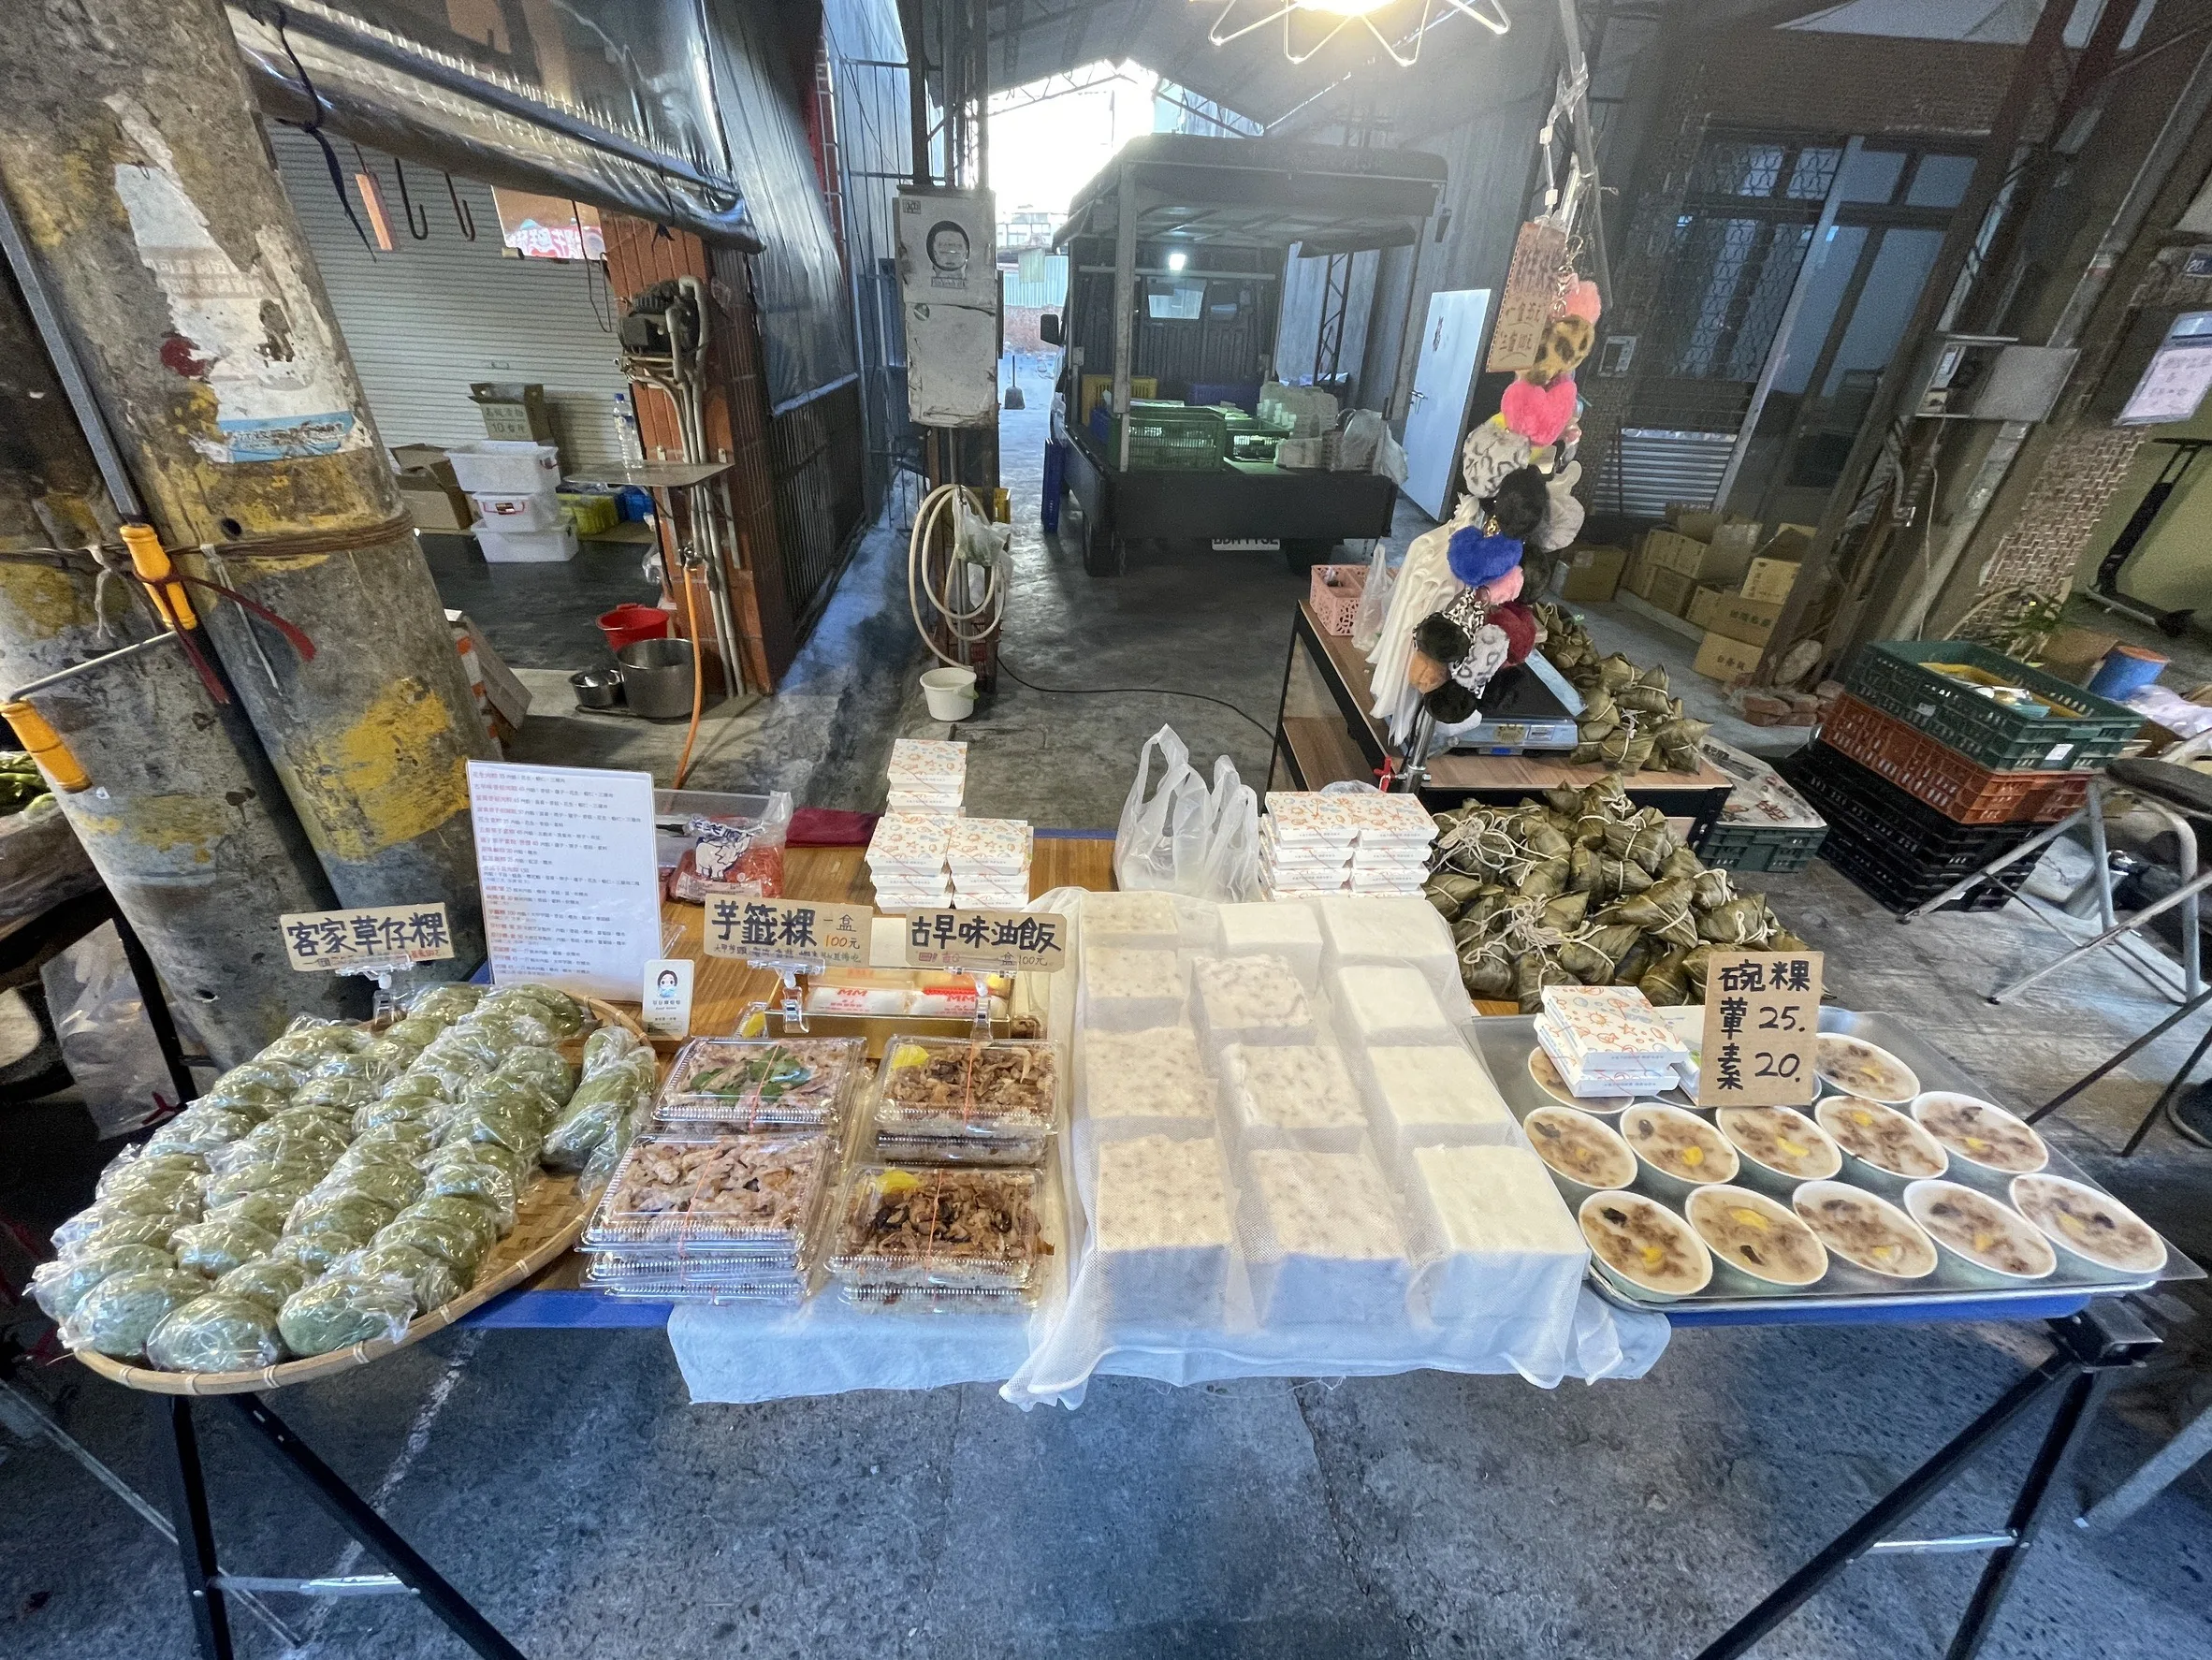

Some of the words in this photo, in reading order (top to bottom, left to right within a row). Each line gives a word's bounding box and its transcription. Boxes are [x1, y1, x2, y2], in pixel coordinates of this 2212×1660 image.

[286, 911, 449, 957] 客家草仔粿
[825, 936, 860, 950] 100元
[911, 914, 1062, 954] 古早味油飯
[1718, 959, 1811, 993] 碗粿
[1720, 997, 1748, 1041] 葷
[1717, 1042, 1744, 1091] 素
